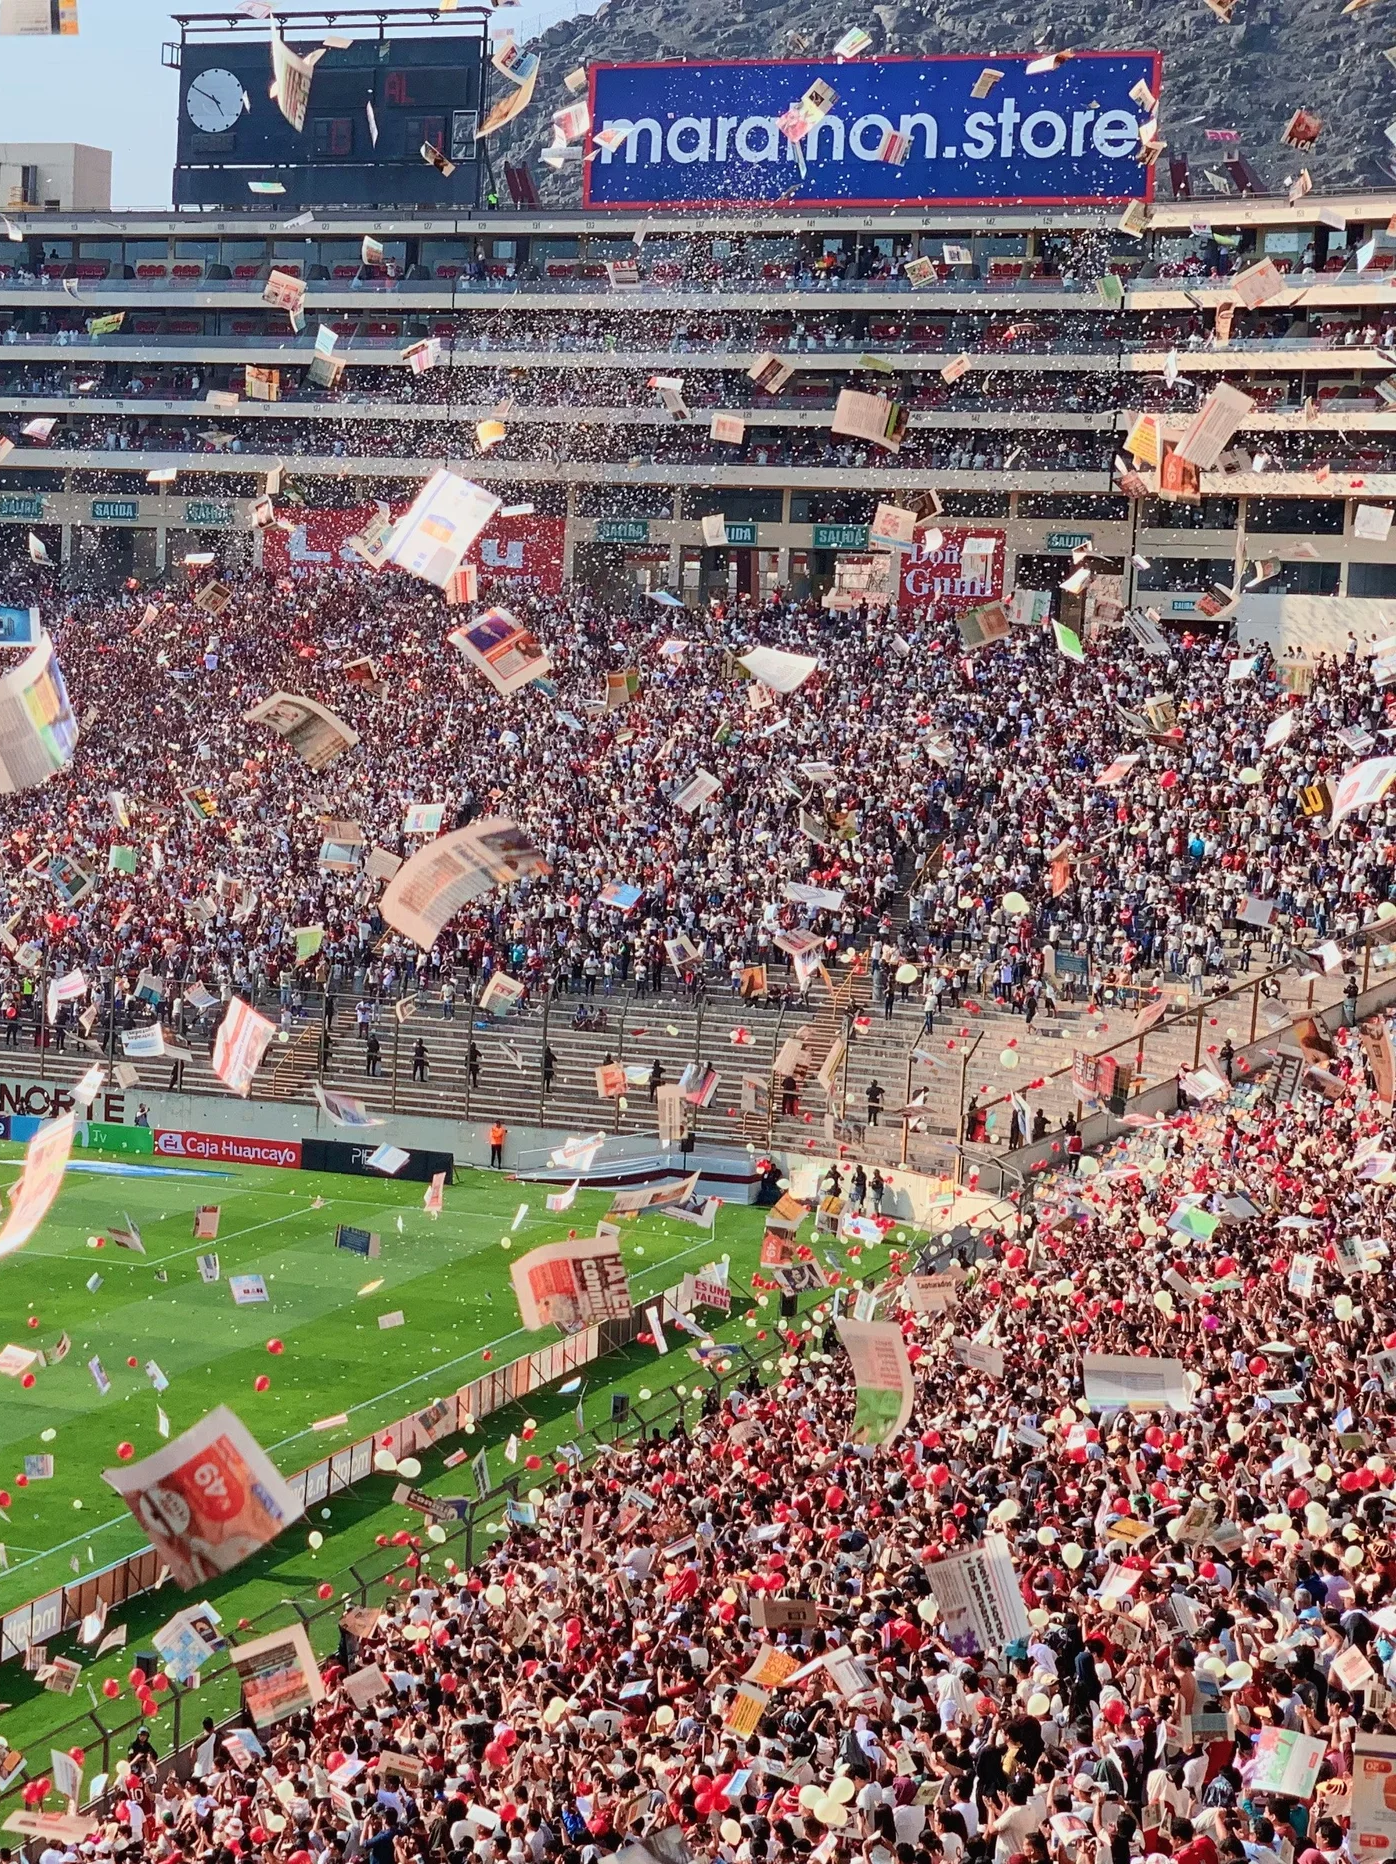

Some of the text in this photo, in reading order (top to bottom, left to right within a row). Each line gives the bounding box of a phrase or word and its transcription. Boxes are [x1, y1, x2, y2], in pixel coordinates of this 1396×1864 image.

[600, 97, 1139, 164] marahon.store
[95, 503, 133, 517] SALIDA
[725, 527, 751, 541] LIDA
[819, 530, 862, 544] SALIDA
[910, 543, 962, 564] Doñ
[186, 1137, 296, 1166] Caja Huancayo
[694, 1280, 731, 1298] ES UNA
[917, 1281, 952, 1290] Capturados
[976, 1554, 992, 1591] Vuelve
[989, 1601, 1006, 1641] sorteo
[972, 1579, 993, 1640] peruanos
[604, 1719, 612, 1736] 7
[129, 1788, 143, 1802] 10
